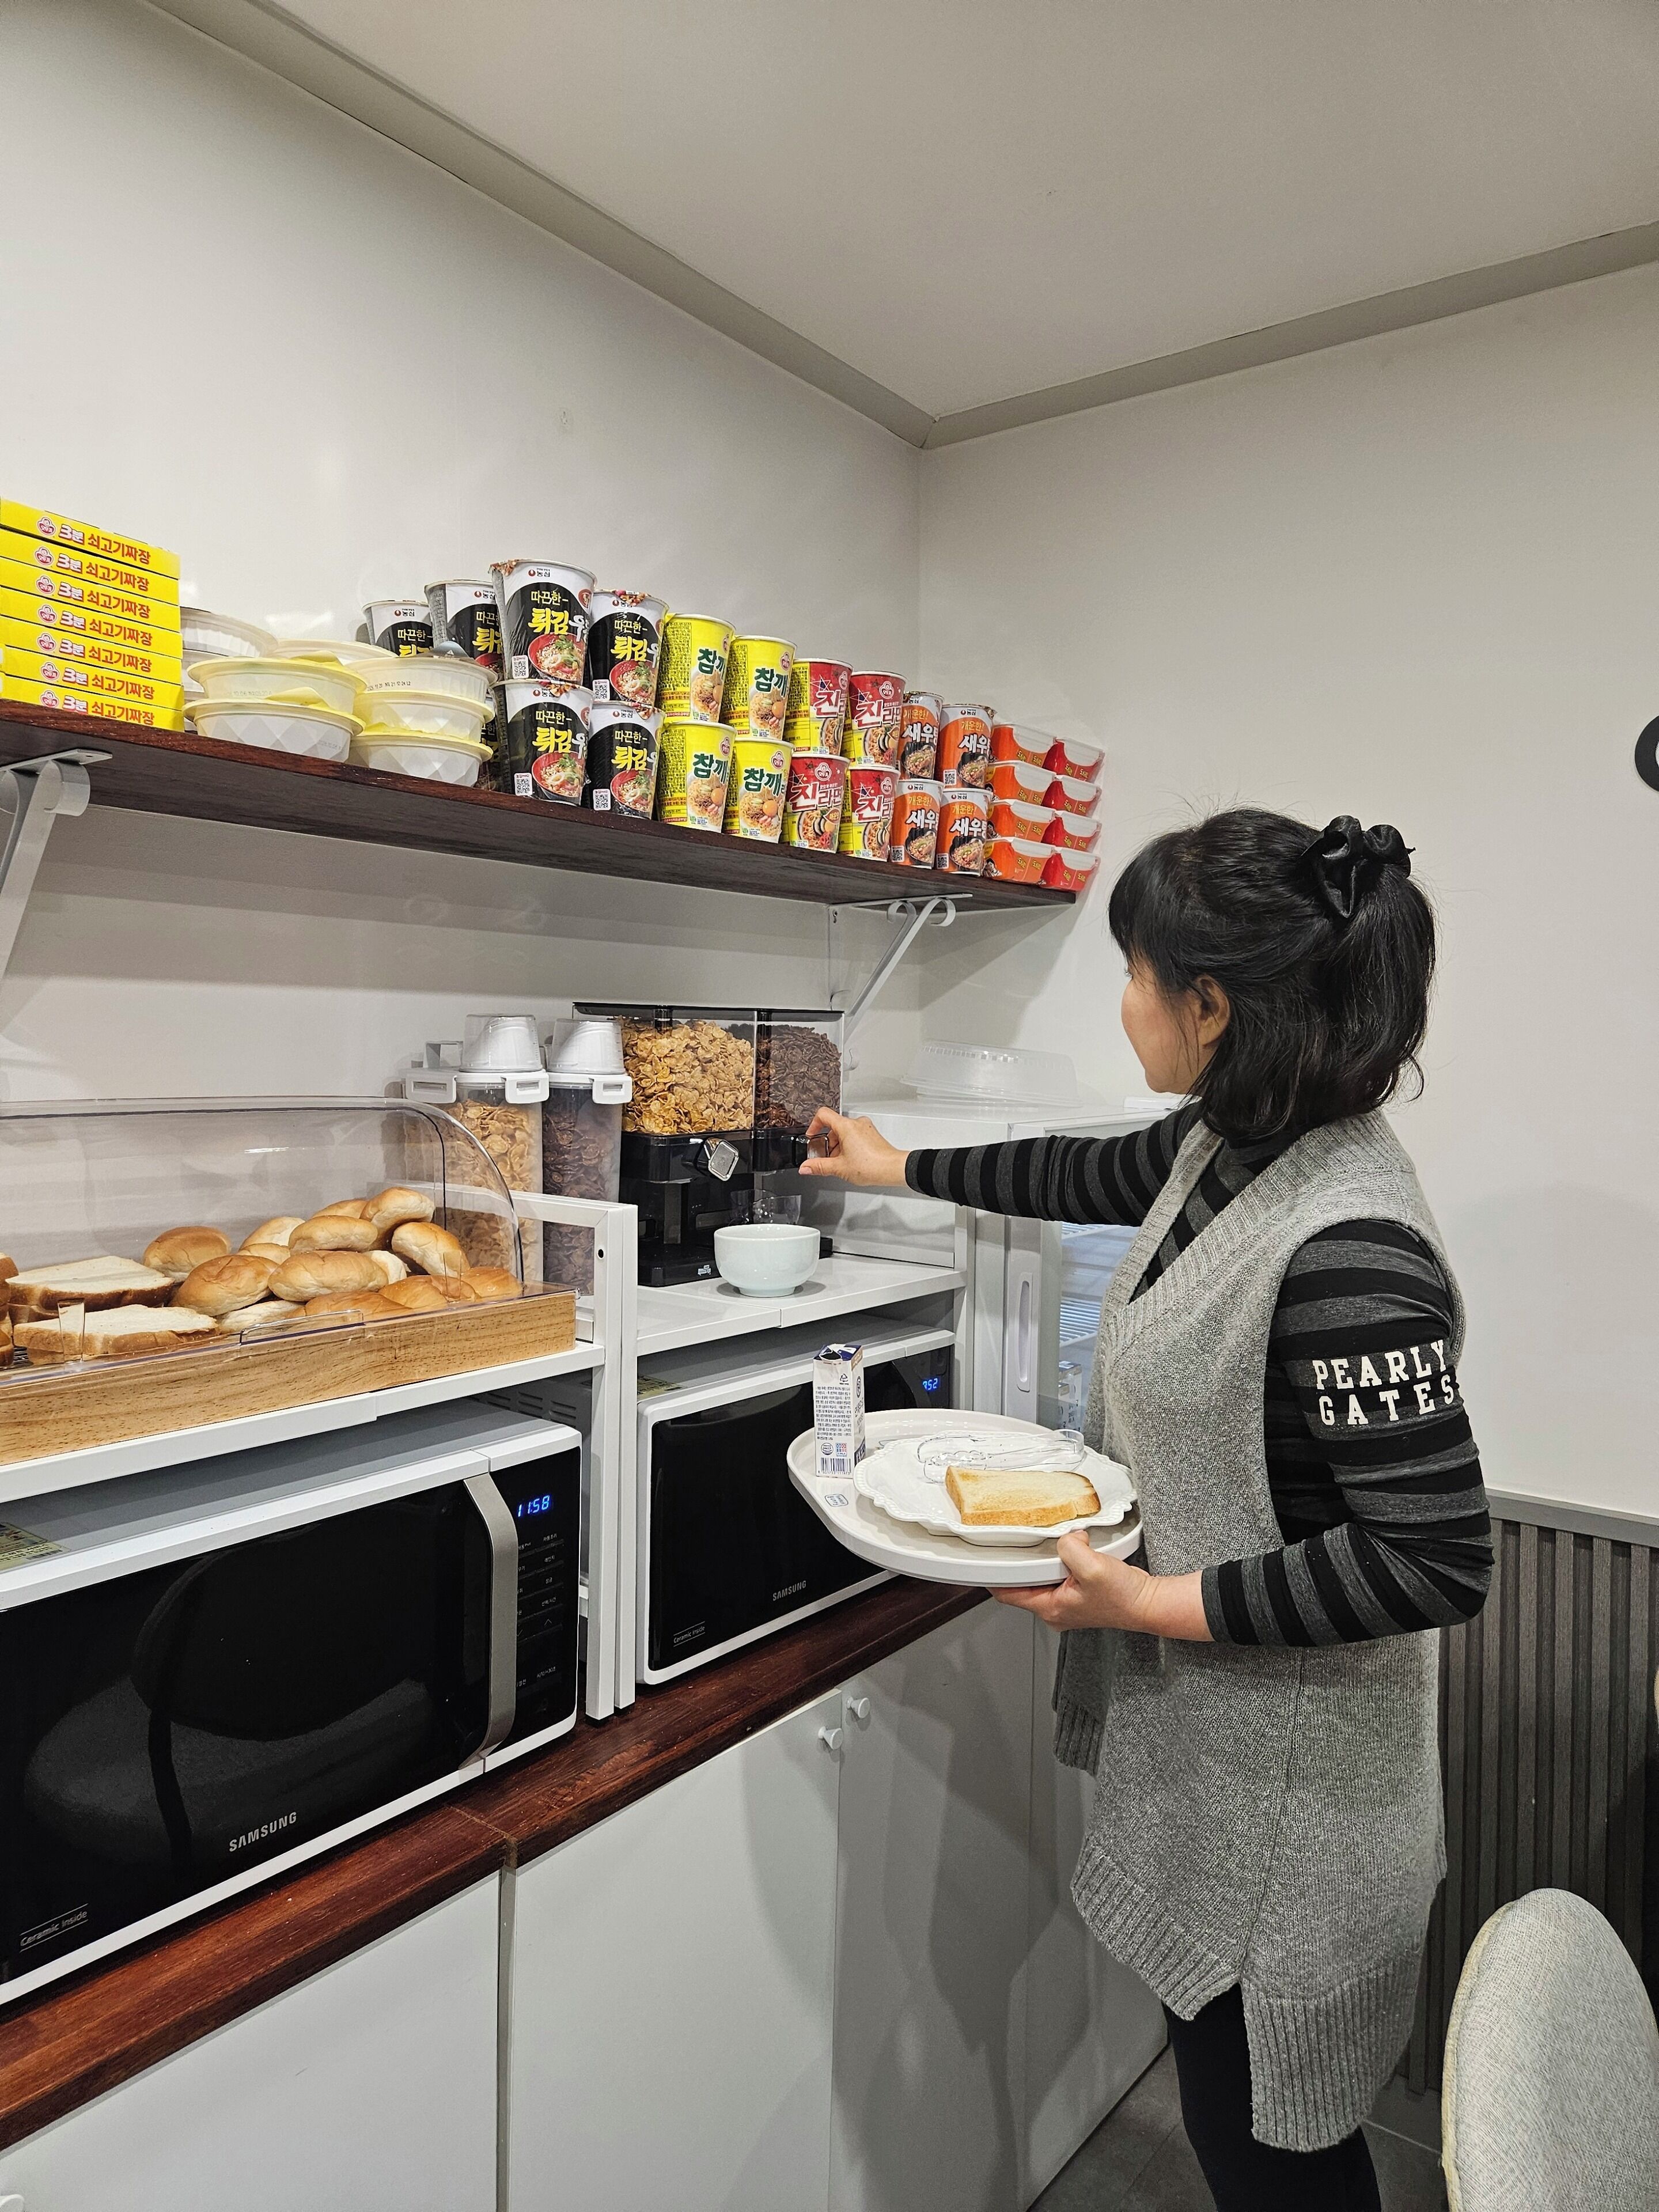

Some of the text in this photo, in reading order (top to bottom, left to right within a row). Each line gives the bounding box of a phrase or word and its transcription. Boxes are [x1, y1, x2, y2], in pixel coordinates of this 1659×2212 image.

[59, 524, 151, 565] 3분 쇠고기짜장
[56, 553, 149, 592] 3분 쇠고기짜장
[58, 581, 150, 619] 3분 쇠고기짜장
[60, 611, 153, 646] 3분 쇠고기짜장
[59, 639, 151, 672] 3분 쇠고기짜장
[62, 668, 154, 699] 3분 쇠고기짜장
[63, 695, 154, 725] 3분 쇠고기짜장
[1312, 1339, 1446, 1389] PEARLY
[1319, 1374, 1454, 1426] GATES
[518, 1495, 550, 1517] 11:58
[772, 1580, 806, 1601] SAMSUNG
[673, 1625, 705, 1643] Ceramic Inside
[229, 1812, 297, 1852] SAMSUNG
[20, 1911, 88, 1946] Ceramic Inside
